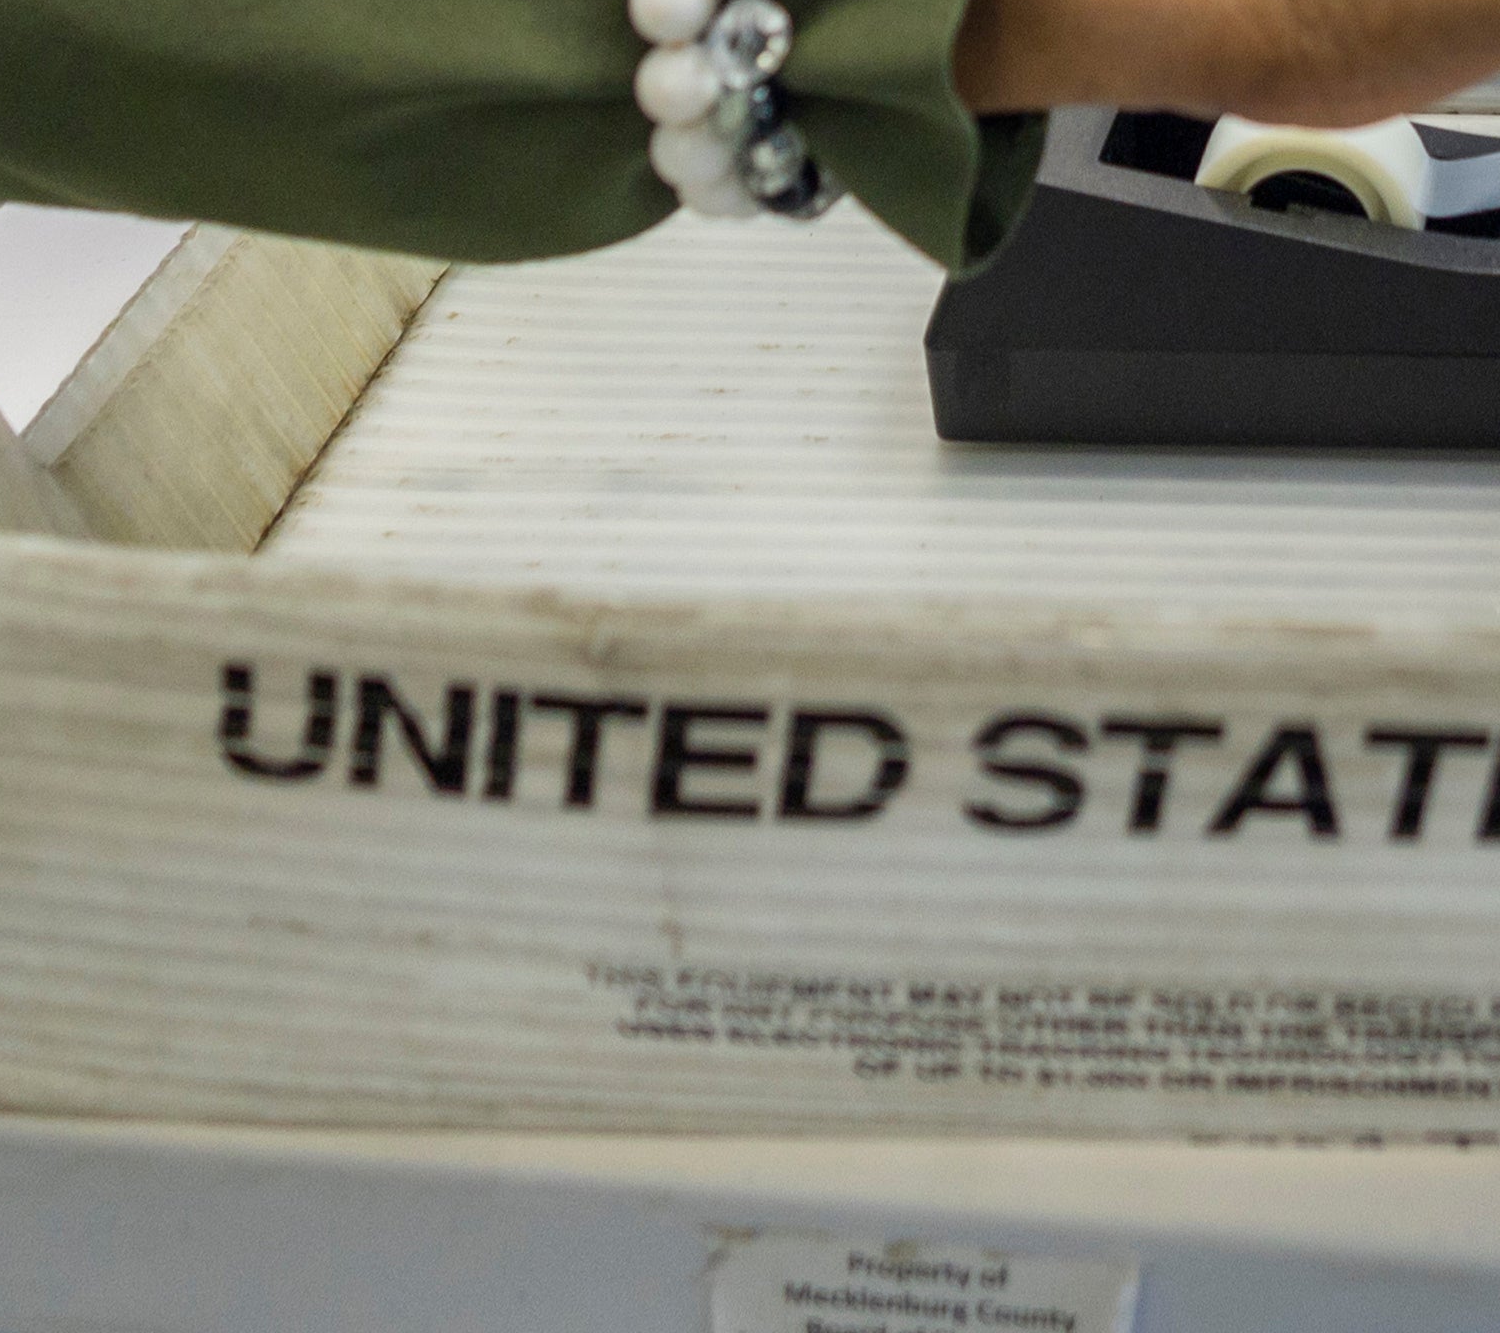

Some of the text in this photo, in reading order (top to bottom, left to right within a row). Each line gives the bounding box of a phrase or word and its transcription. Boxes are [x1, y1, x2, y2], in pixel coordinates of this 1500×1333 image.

[219, 661, 913, 822] UNITED
[847, 1249, 970, 1289] Property
[976, 1299, 1077, 1332] County
